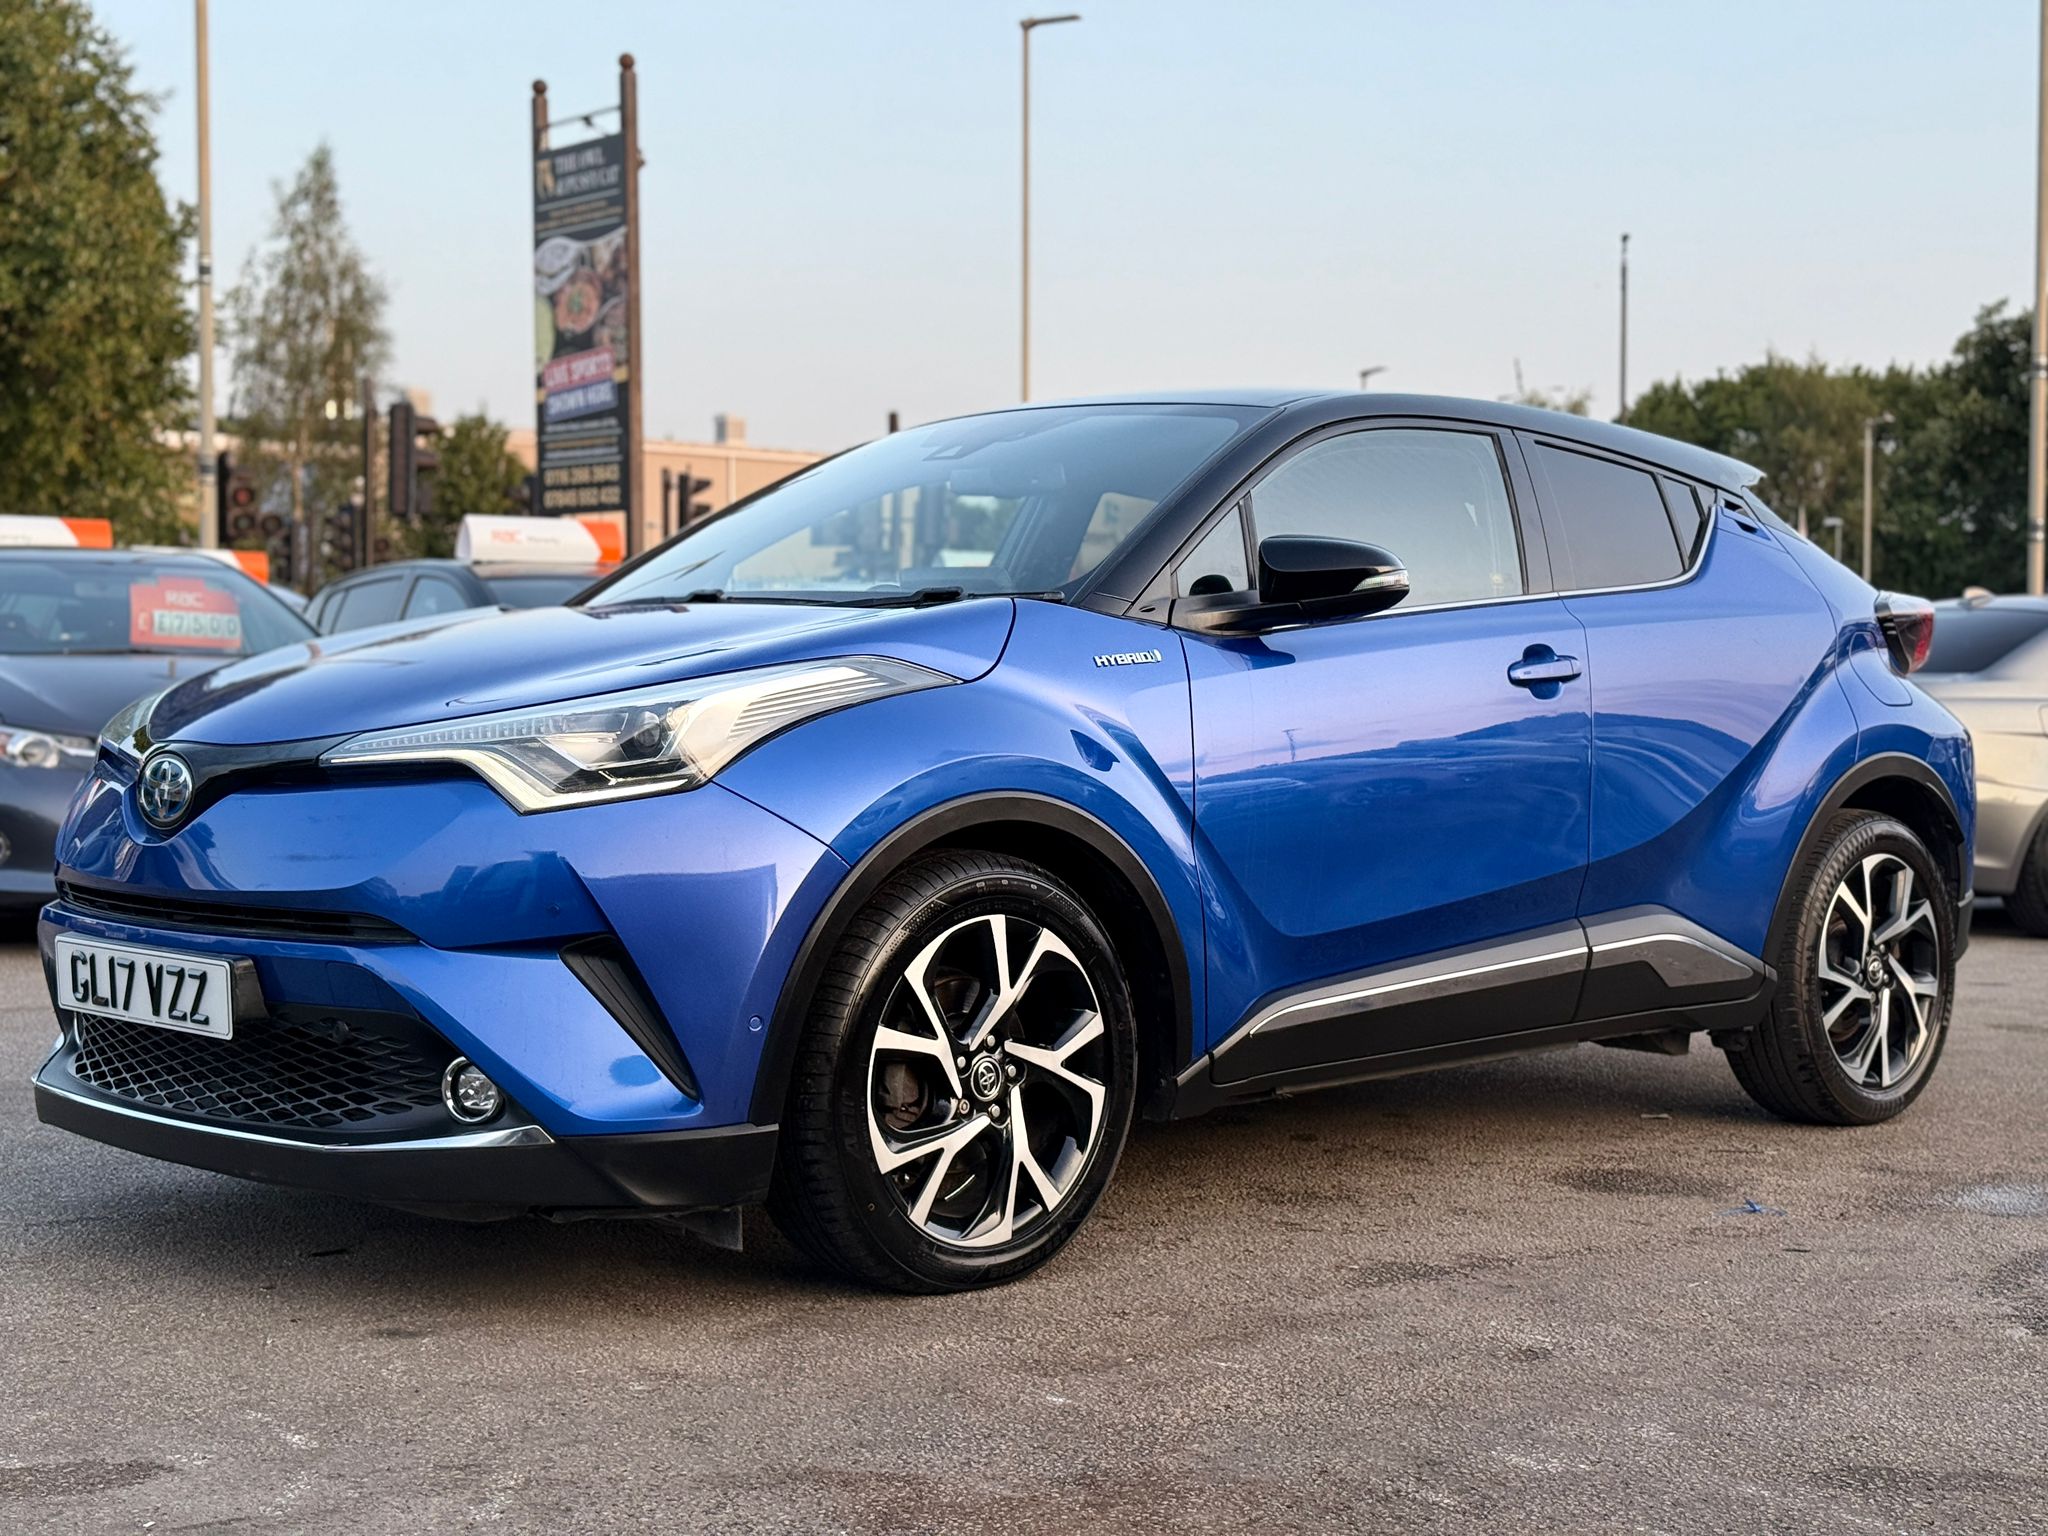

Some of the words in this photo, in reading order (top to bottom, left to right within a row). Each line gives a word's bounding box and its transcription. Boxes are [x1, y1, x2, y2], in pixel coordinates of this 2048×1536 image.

[545, 363, 569, 387] LIVE
[1093, 650, 1155, 667] HYBRID
[71, 950, 135, 1011] GL17
[144, 961, 210, 1025] VZZ
